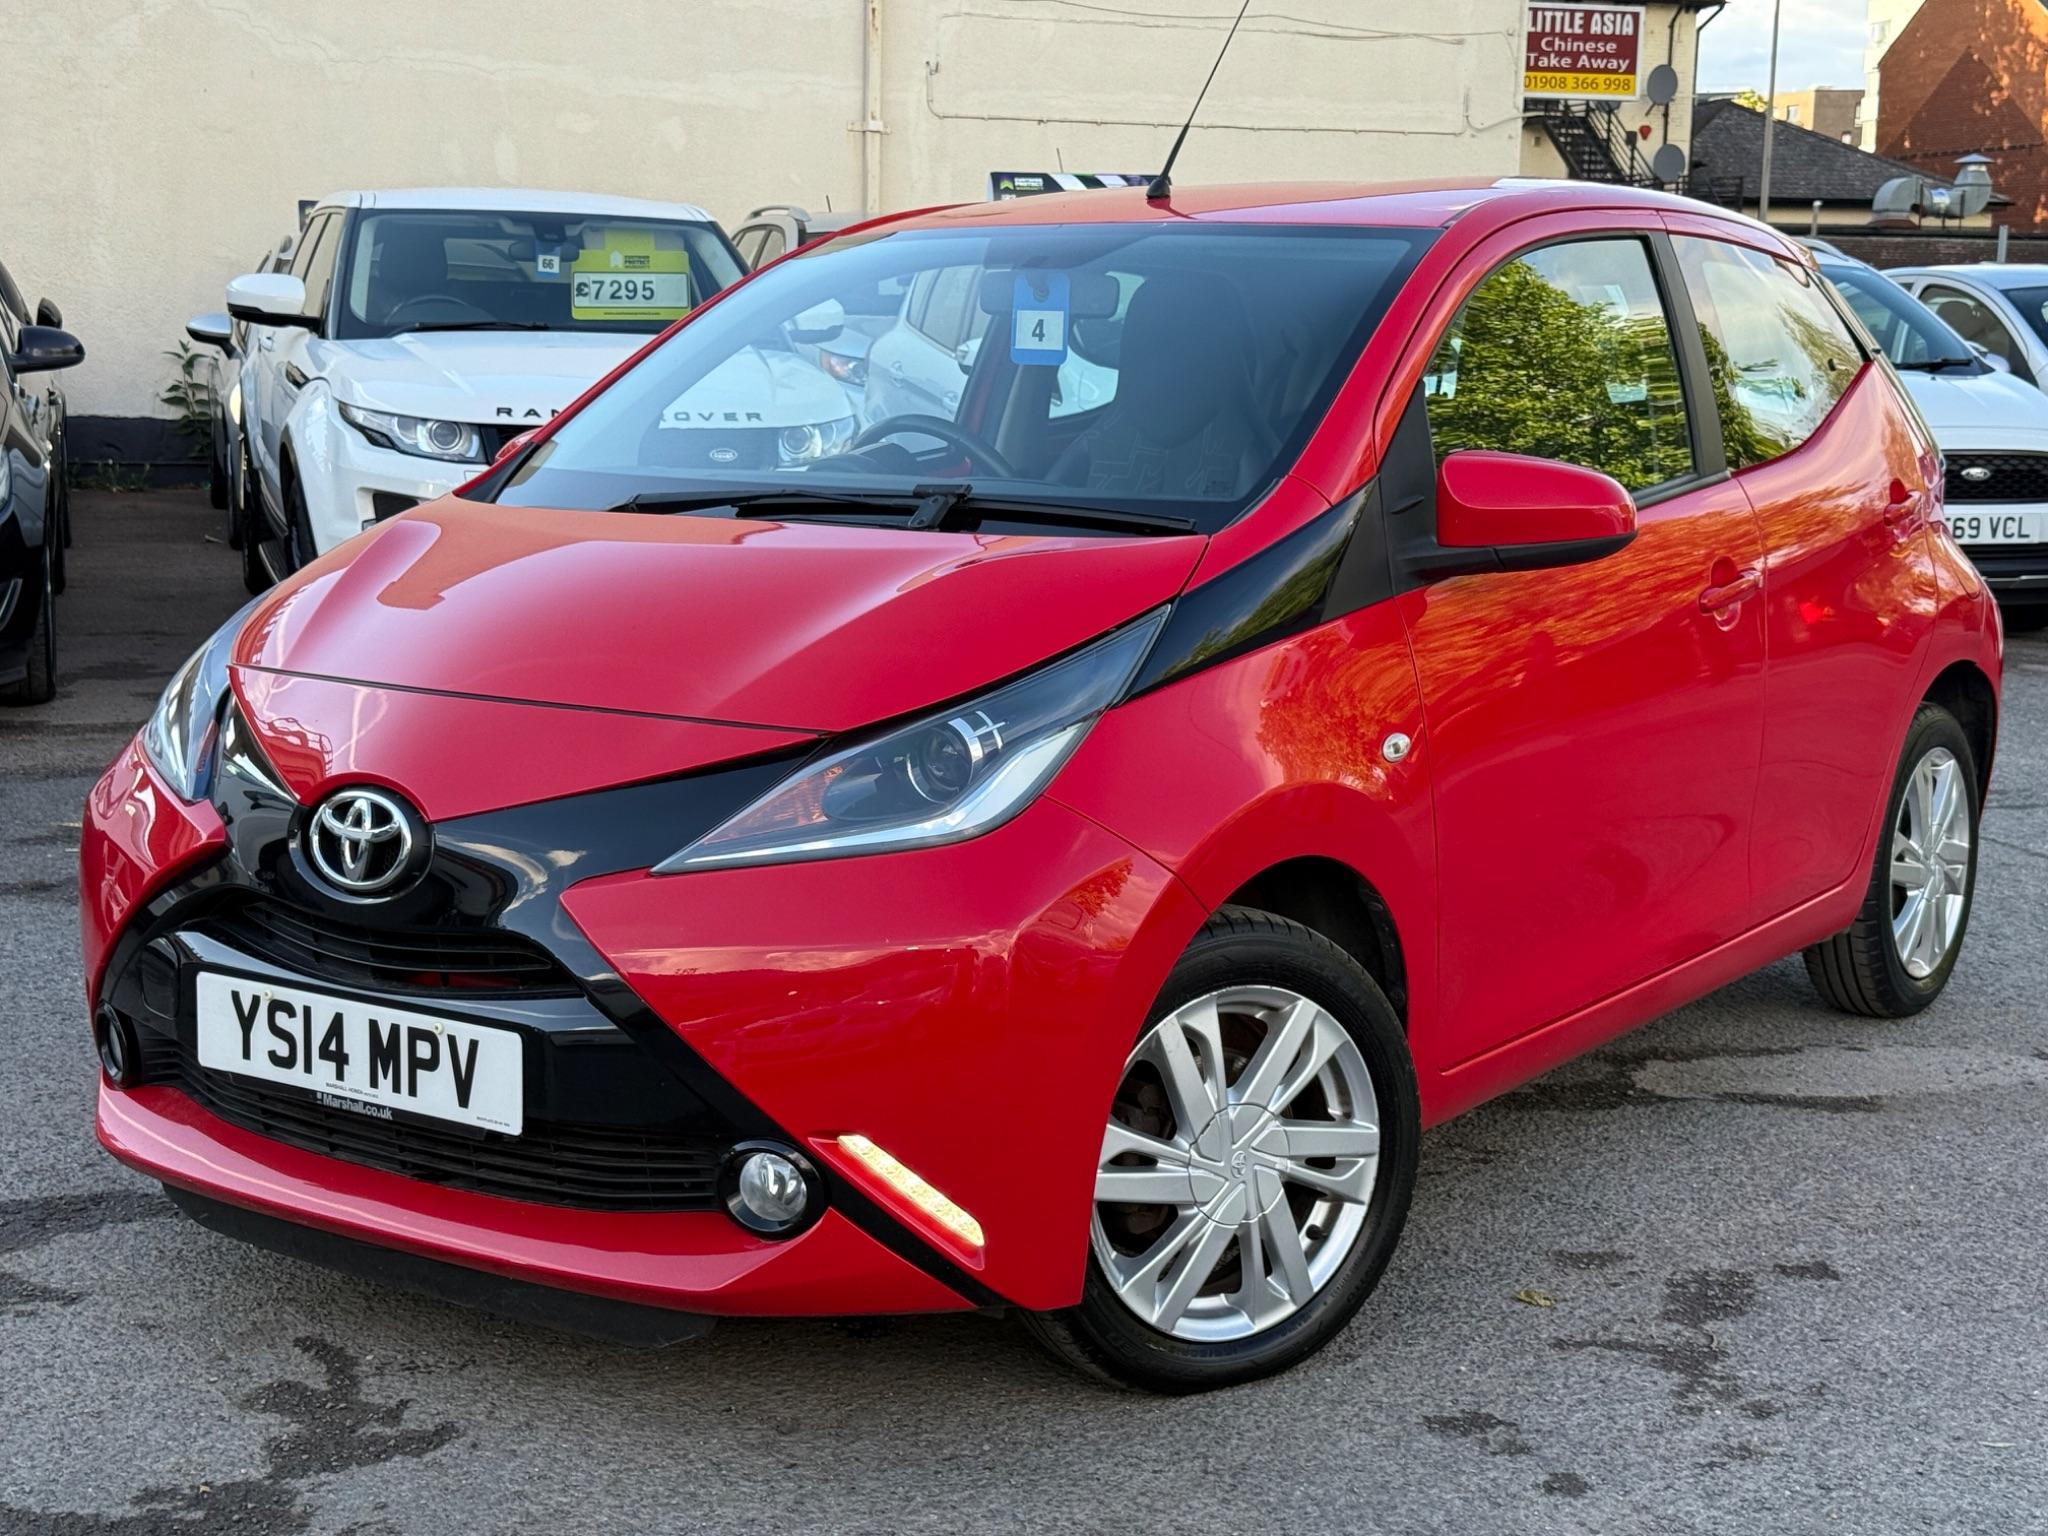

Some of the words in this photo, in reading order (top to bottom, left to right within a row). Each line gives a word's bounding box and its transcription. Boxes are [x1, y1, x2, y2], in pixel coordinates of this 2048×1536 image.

[1528, 10, 1584, 34] LITTLE
[1590, 13, 1634, 35] ASIA
[1541, 37, 1617, 53] Chinese
[1527, 53, 1572, 68] Take
[1577, 55, 1629, 72] Away
[1524, 75, 1567, 89] 01908
[1570, 77, 1599, 90] 366
[1603, 78, 1631, 91] 998
[542, 258, 555, 270] 66
[575, 280, 655, 300] £7295
[1031, 318, 1045, 342] 4
[660, 411, 763, 422] OVER
[1946, 517, 1981, 539] 69
[1989, 516, 2030, 539] VCL
[231, 989, 350, 1083] YS14
[368, 1018, 480, 1109] MPV
[323, 1093, 393, 1120] Marshall.co.uk
